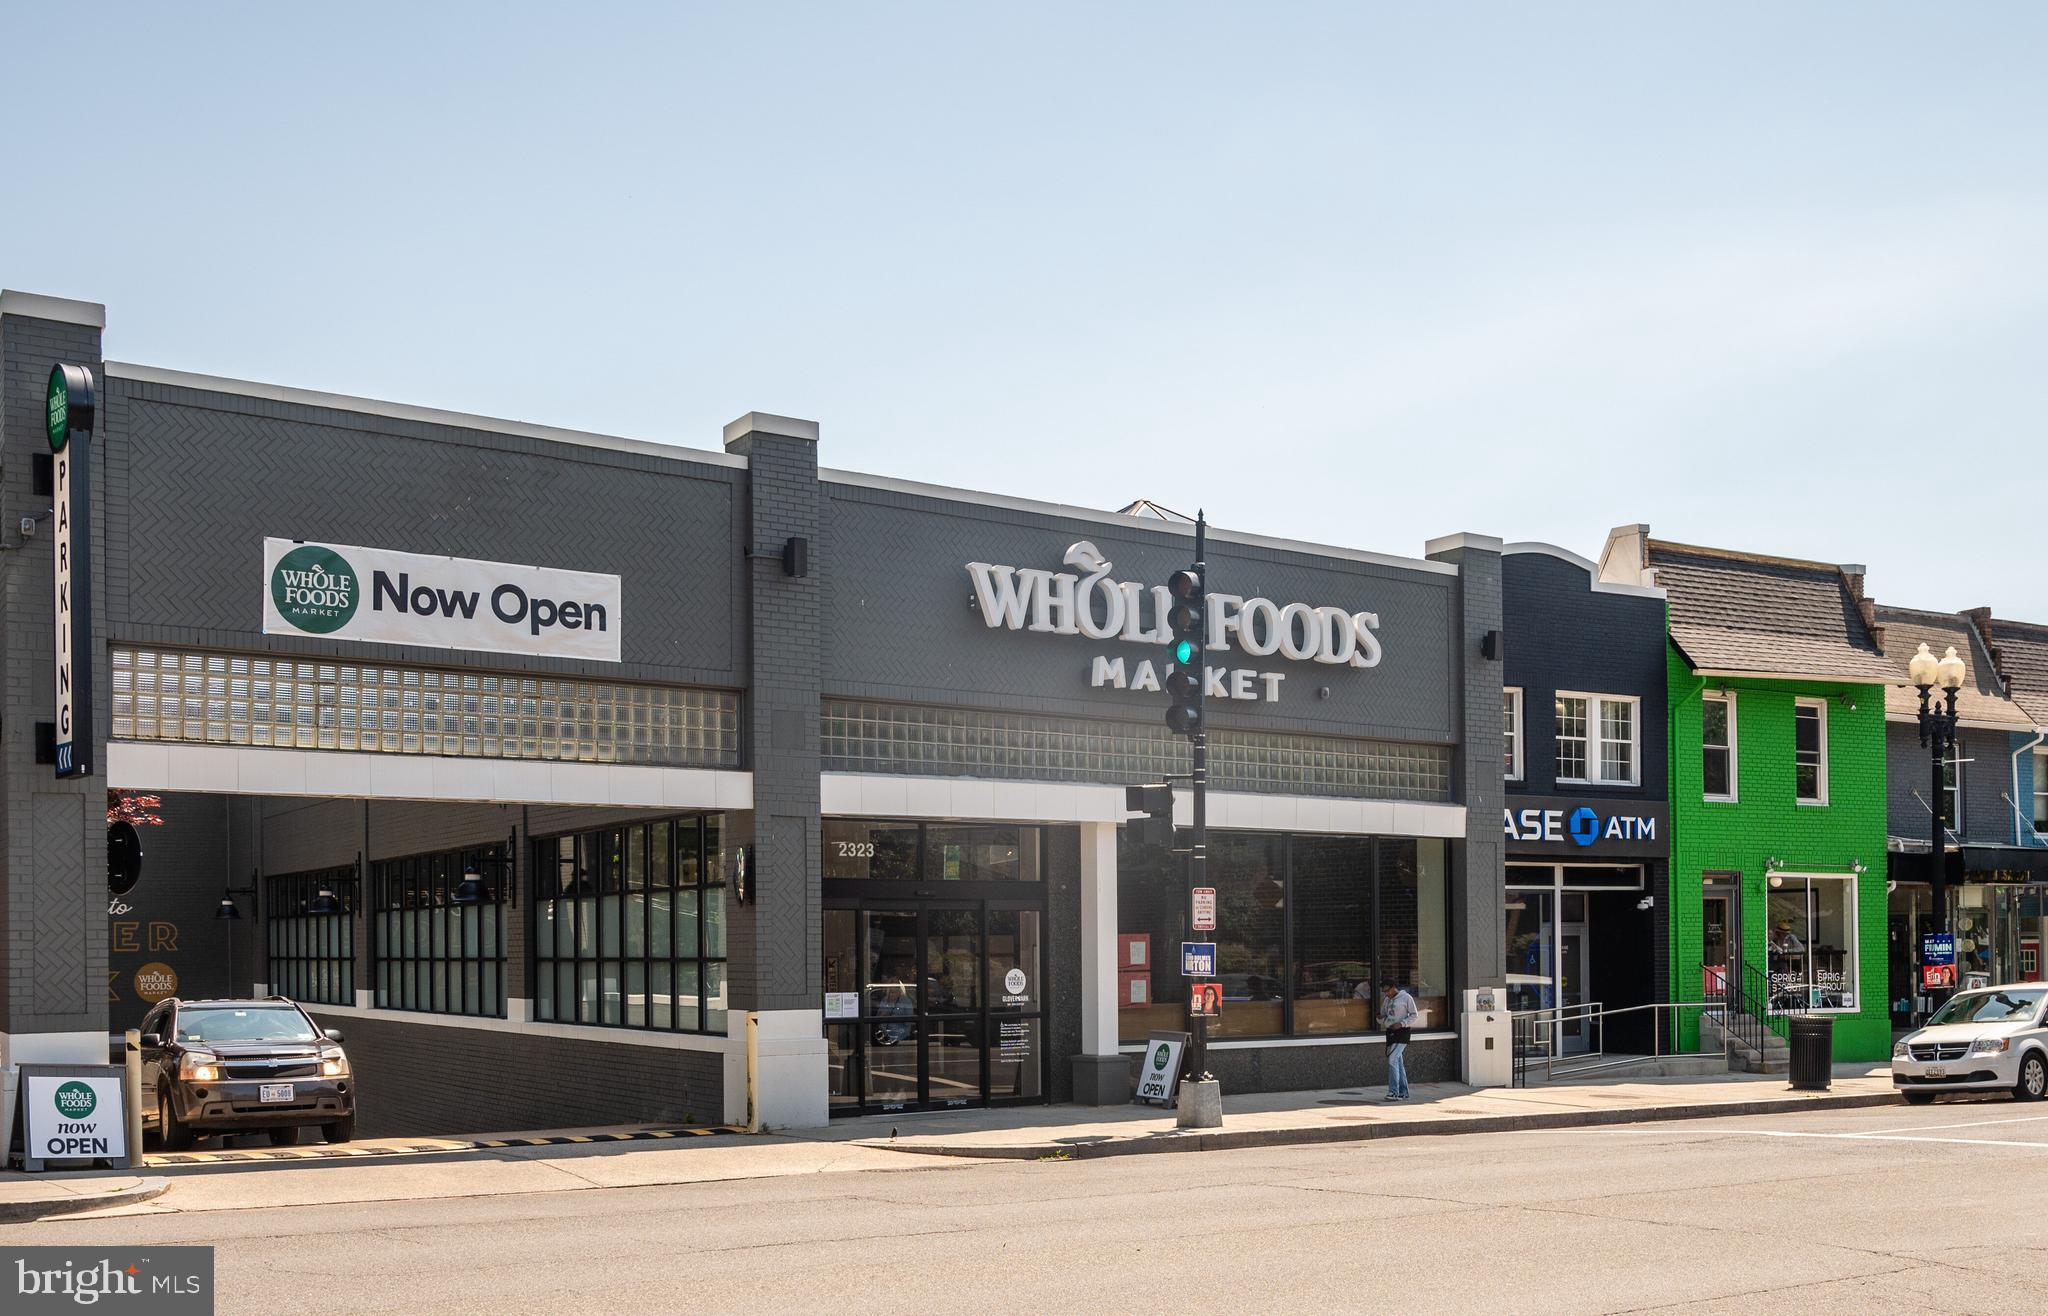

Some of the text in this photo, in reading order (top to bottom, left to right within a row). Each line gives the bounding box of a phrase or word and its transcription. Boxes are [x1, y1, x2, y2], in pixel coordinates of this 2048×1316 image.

[281, 568, 351, 592] WHOLE
[58, 460, 70, 736] PARKING
[285, 586, 349, 608] FOODS
[372, 570, 607, 636] Now Open
[292, 607, 340, 617] MARKET
[1206, 591, 1382, 669] FOODS
[1090, 655, 1286, 703] MAKET
[1604, 815, 1656, 840] ATM
[838, 843, 875, 857] 2323
[107, 897, 133, 915] to
[138, 974, 174, 983] WHOLE
[1771, 973, 1796, 982] SPRIG
[1817, 972, 1840, 982] SPRIG
[140, 982, 173, 991] FOODS
[1817, 982, 1847, 991] SPROUT
[58, 1092, 93, 1100] WHOLE
[1143, 1083, 1166, 1096] OPEN
[61, 1099, 92, 1107] FOODS
[57, 1123, 97, 1134] now
[47, 1137, 108, 1155] OPEN
